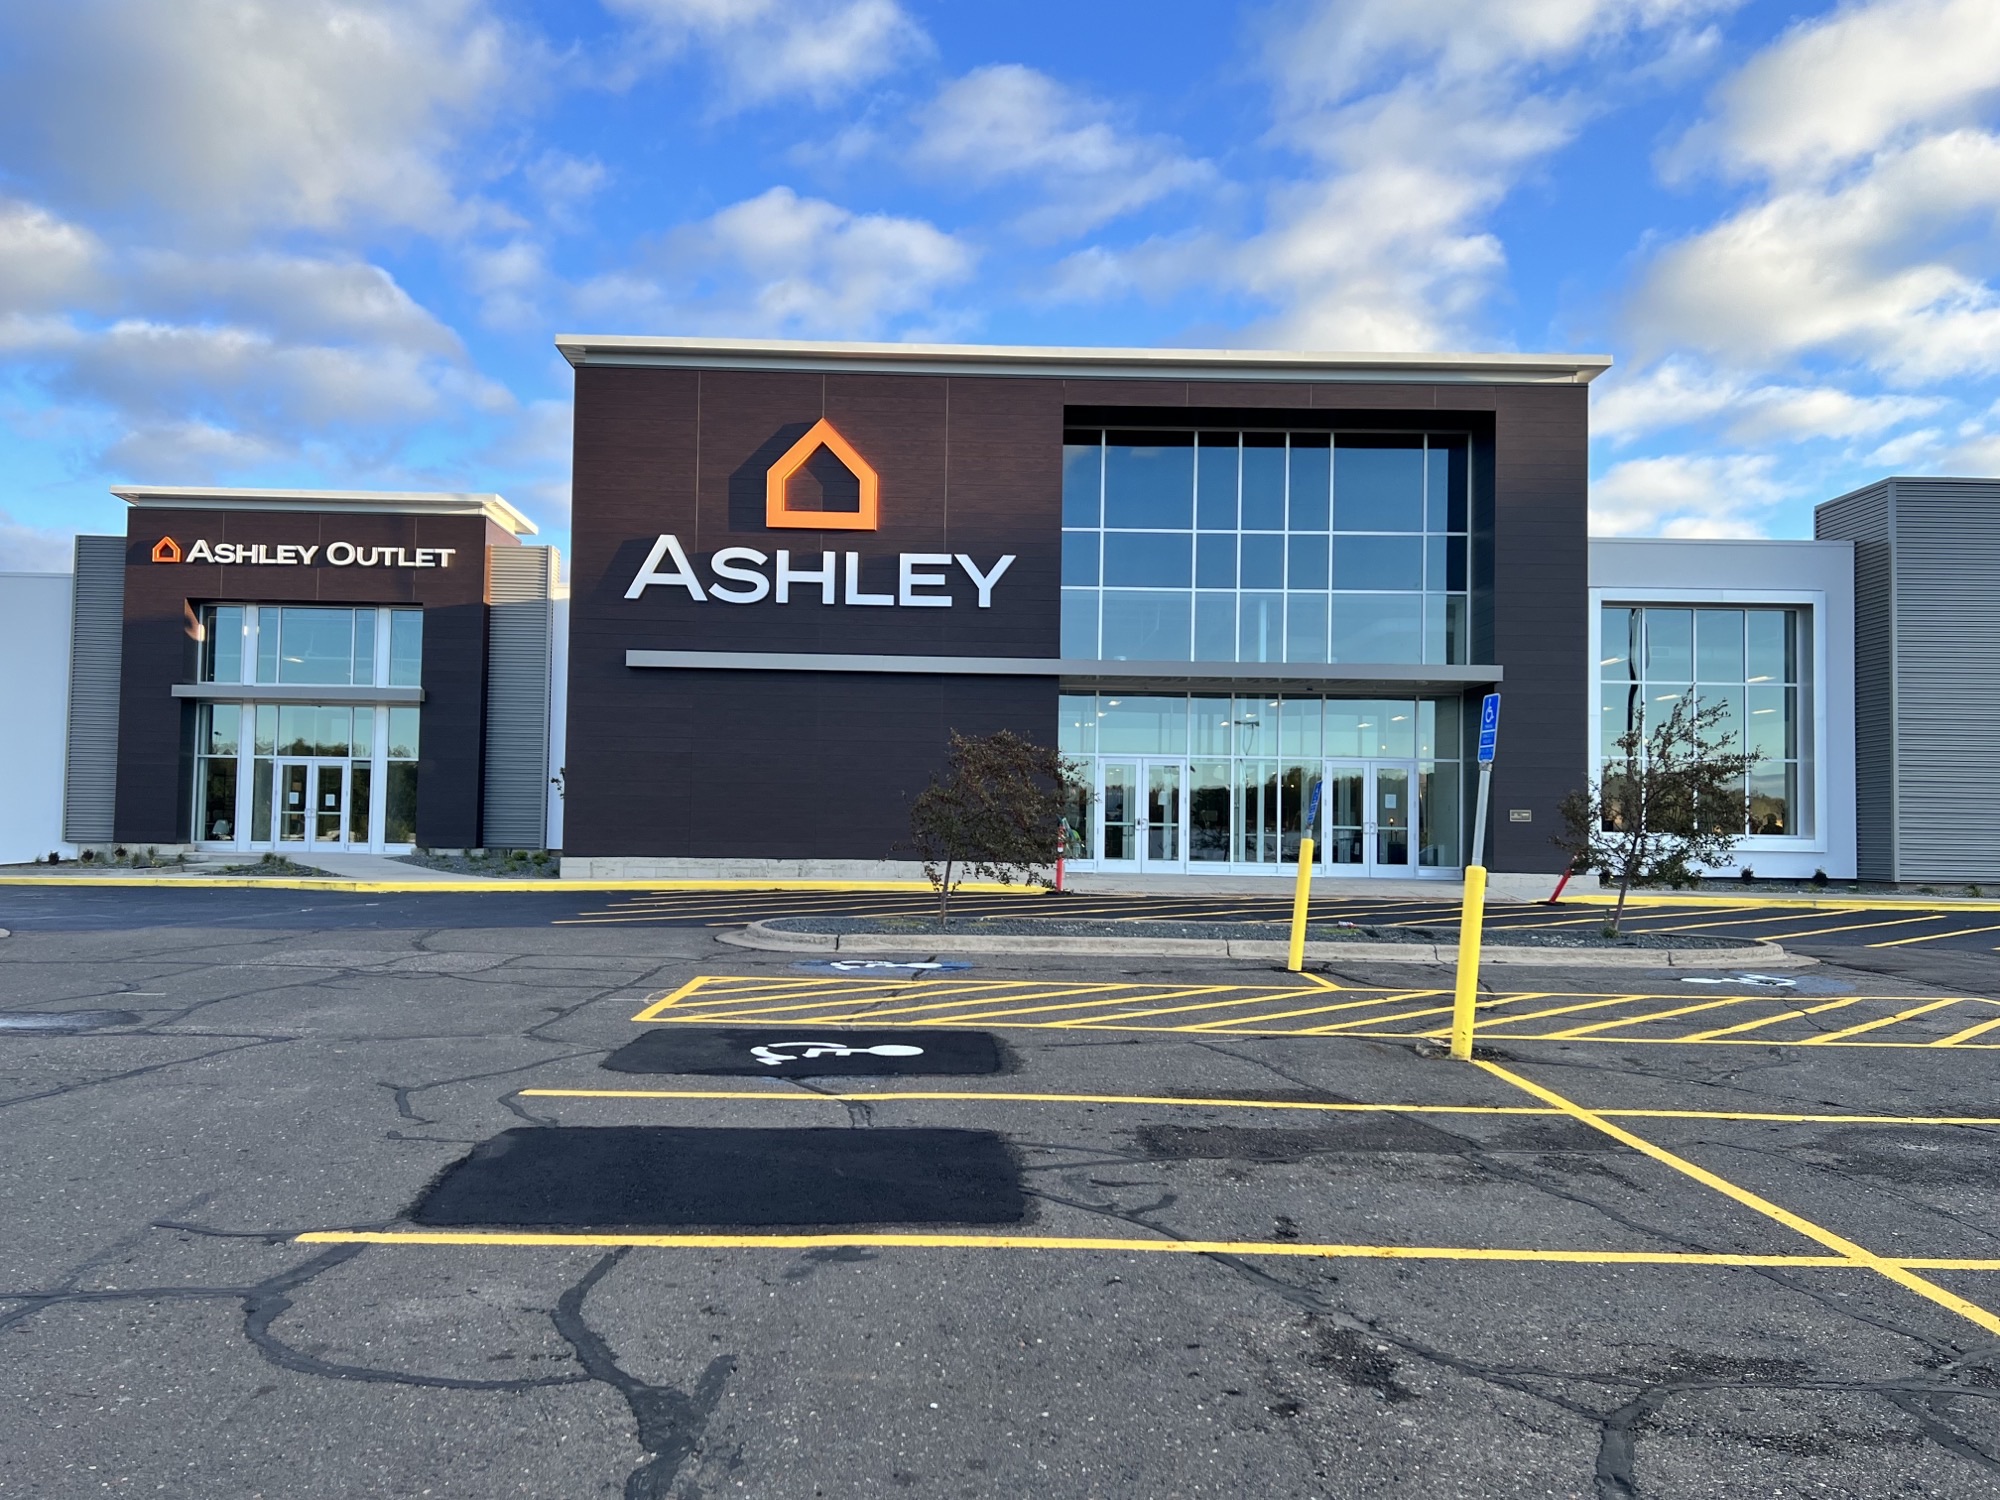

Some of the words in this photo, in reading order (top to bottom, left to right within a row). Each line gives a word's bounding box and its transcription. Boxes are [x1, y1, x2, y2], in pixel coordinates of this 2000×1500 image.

[186, 538, 318, 566] ASHLEY
[325, 541, 456, 568] OUTLET
[624, 533, 1017, 609] ASHLEY
